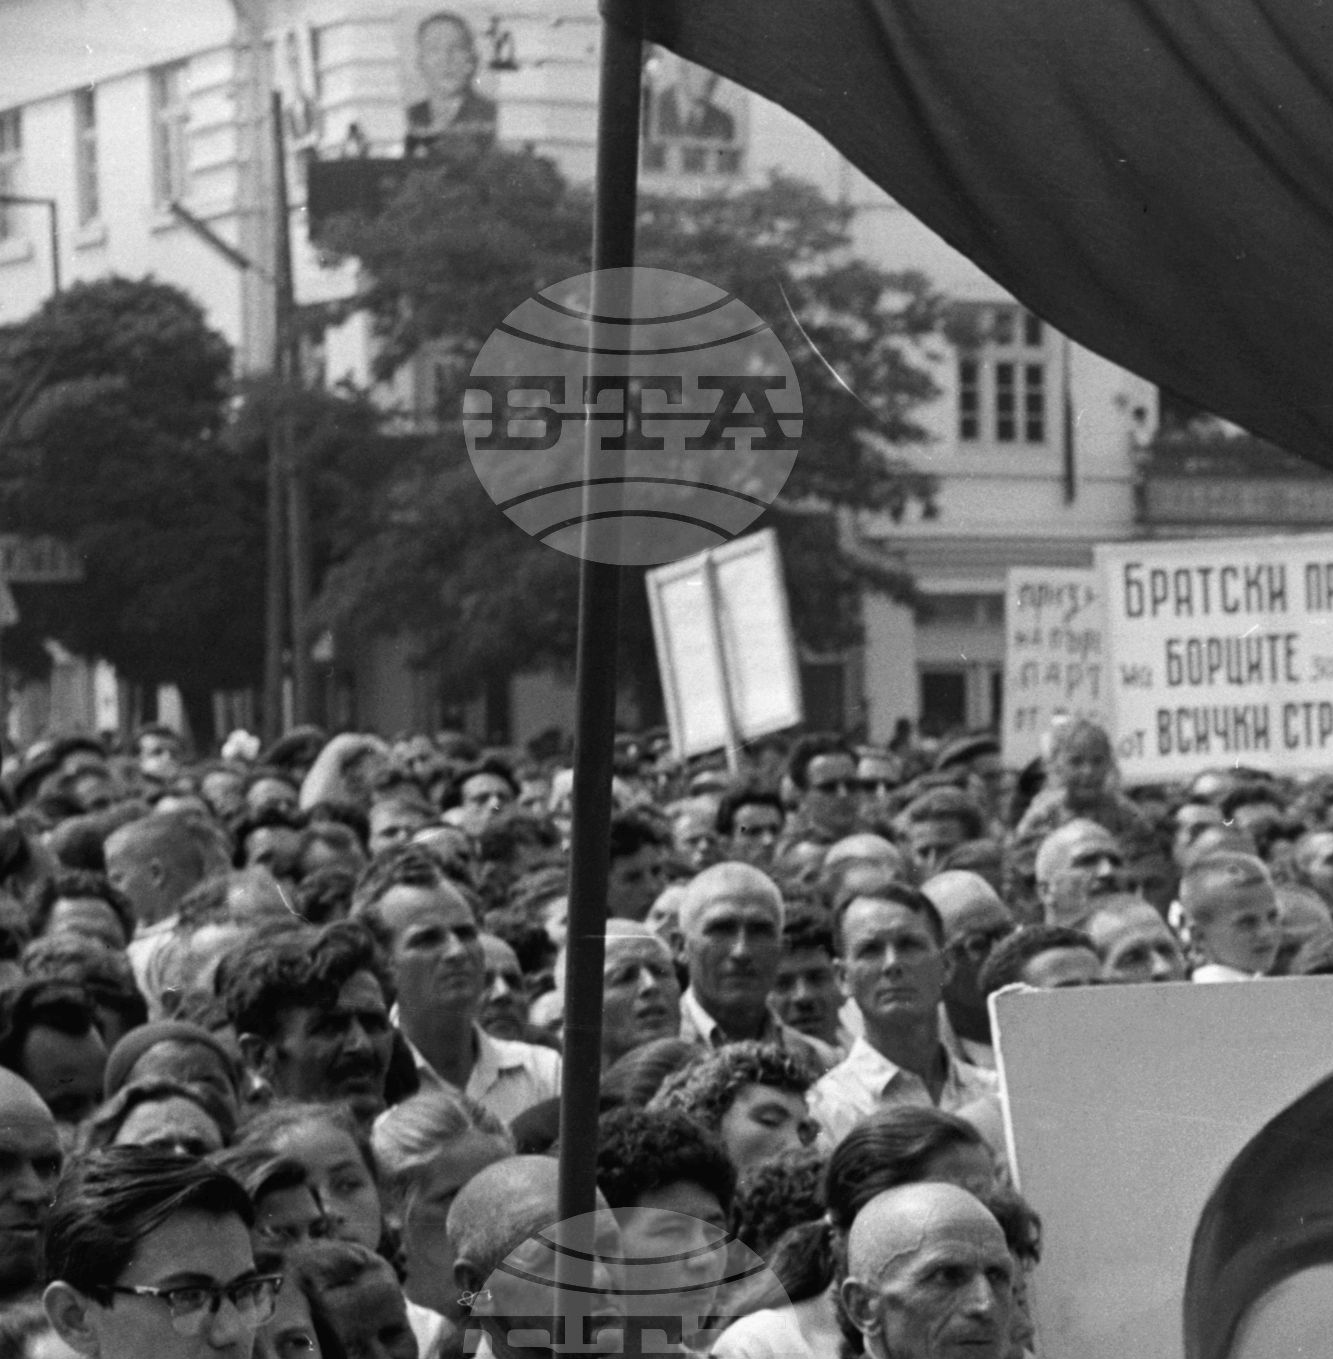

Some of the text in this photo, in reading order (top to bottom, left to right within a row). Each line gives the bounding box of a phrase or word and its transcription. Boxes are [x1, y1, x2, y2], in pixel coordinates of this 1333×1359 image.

[1123, 563, 1287, 618] БРАТСКИ
[1166, 633, 1298, 686] БОРЦИТЕ
[1157, 705, 1270, 756] ВСИЧКИ
